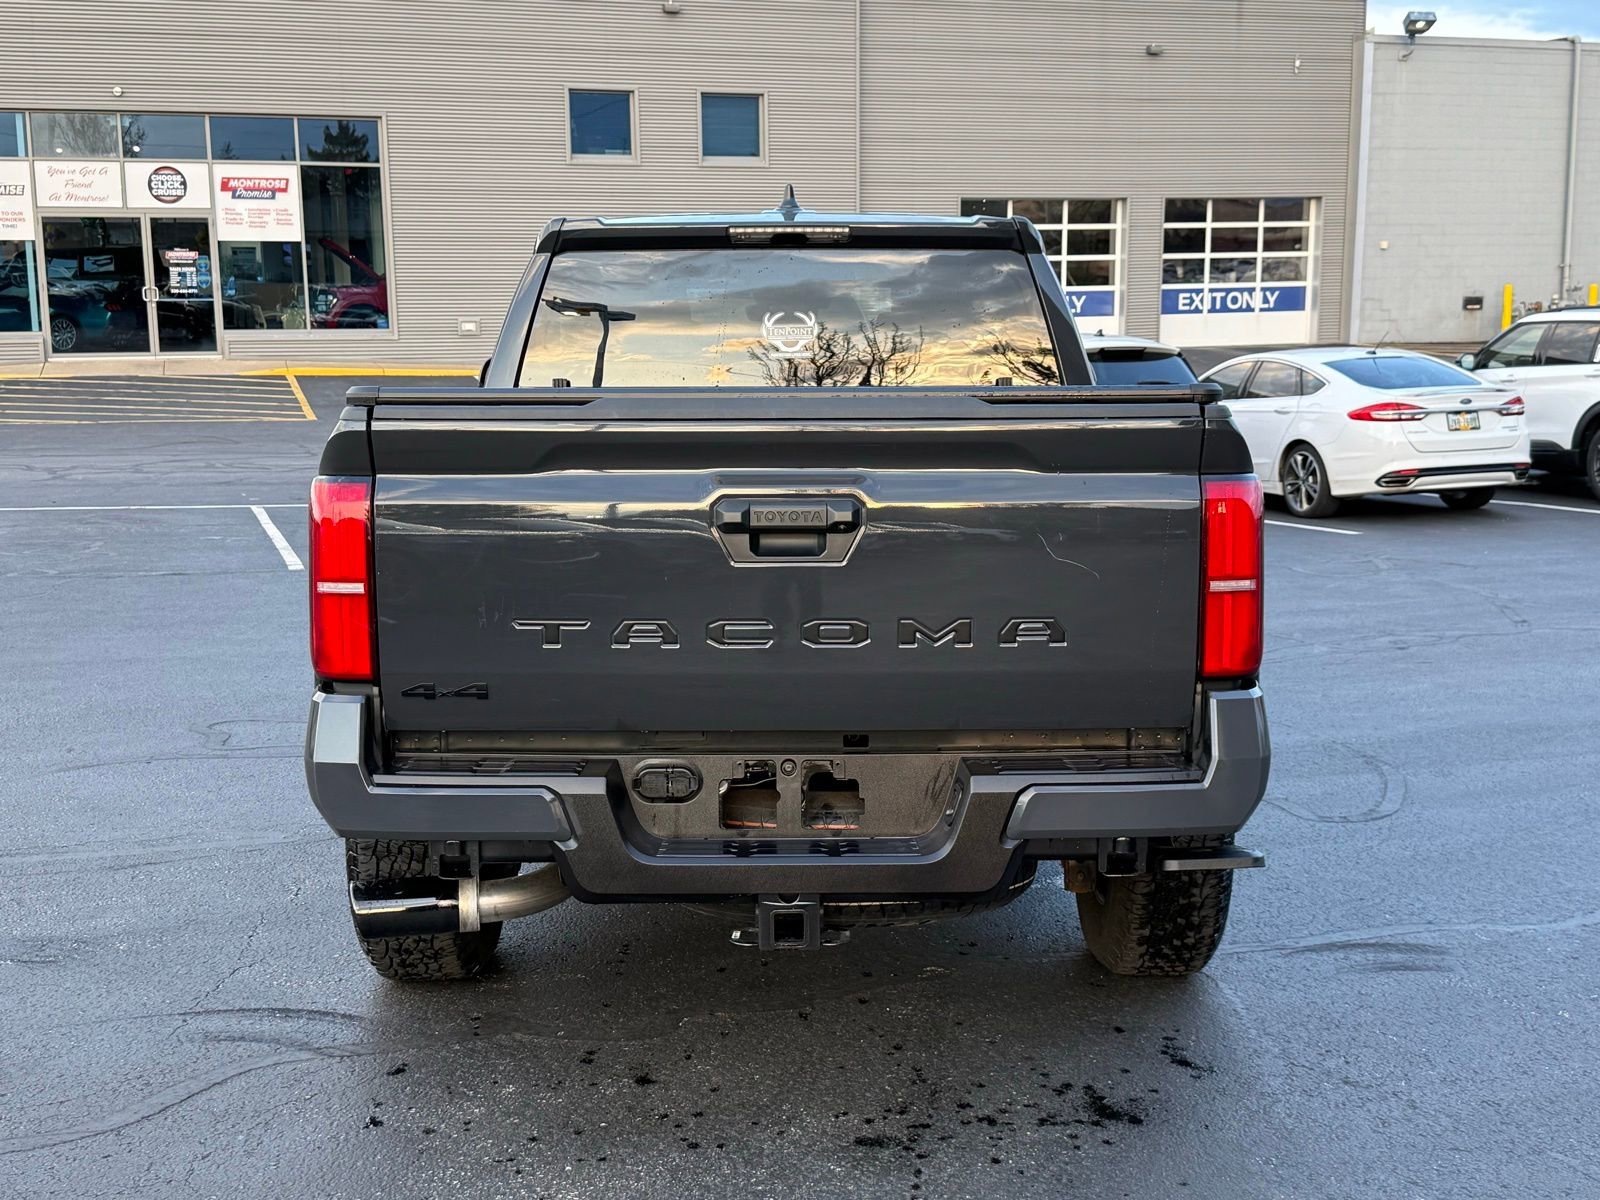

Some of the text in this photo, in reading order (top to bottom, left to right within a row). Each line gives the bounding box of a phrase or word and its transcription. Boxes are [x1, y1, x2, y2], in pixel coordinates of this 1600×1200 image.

[65, 178, 94, 188] Friend
[151, 181, 185, 189] CLICK.
[228, 178, 287, 189] MONTROSE
[235, 187, 274, 198] Promise
[1178, 291, 1280, 310] EXIT ONLY
[753, 510, 824, 523] TOYOTA
[511, 618, 1068, 650] TACOMA
[400, 682, 489, 700] 4x4
